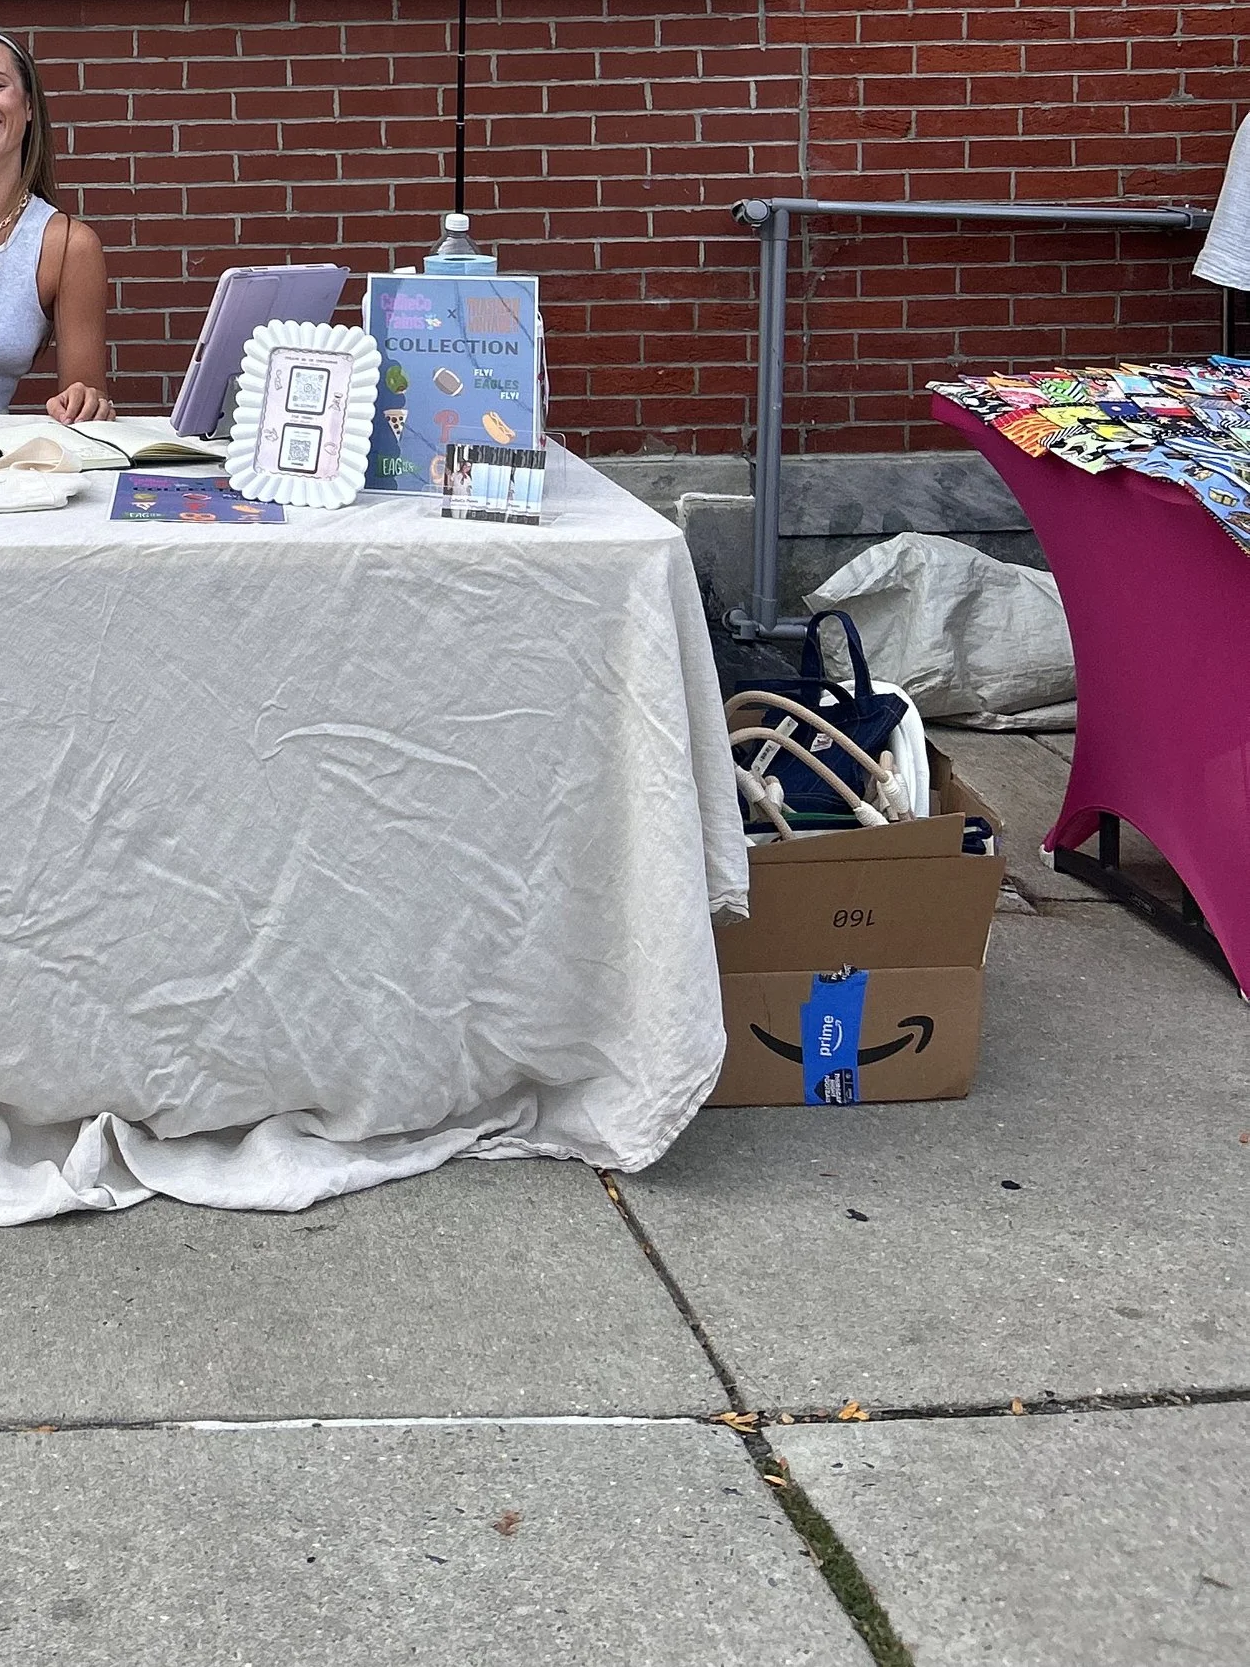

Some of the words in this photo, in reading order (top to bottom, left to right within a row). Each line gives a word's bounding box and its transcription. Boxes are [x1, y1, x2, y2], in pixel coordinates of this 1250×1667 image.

[385, 337, 518, 355] COLLECTION
[474, 368, 493, 377] FLY!
[474, 378, 519, 390] EAGLES
[500, 391, 519, 399] FLY!
[833, 909, 875, 928] 160
[818, 1015, 834, 1056] prime
